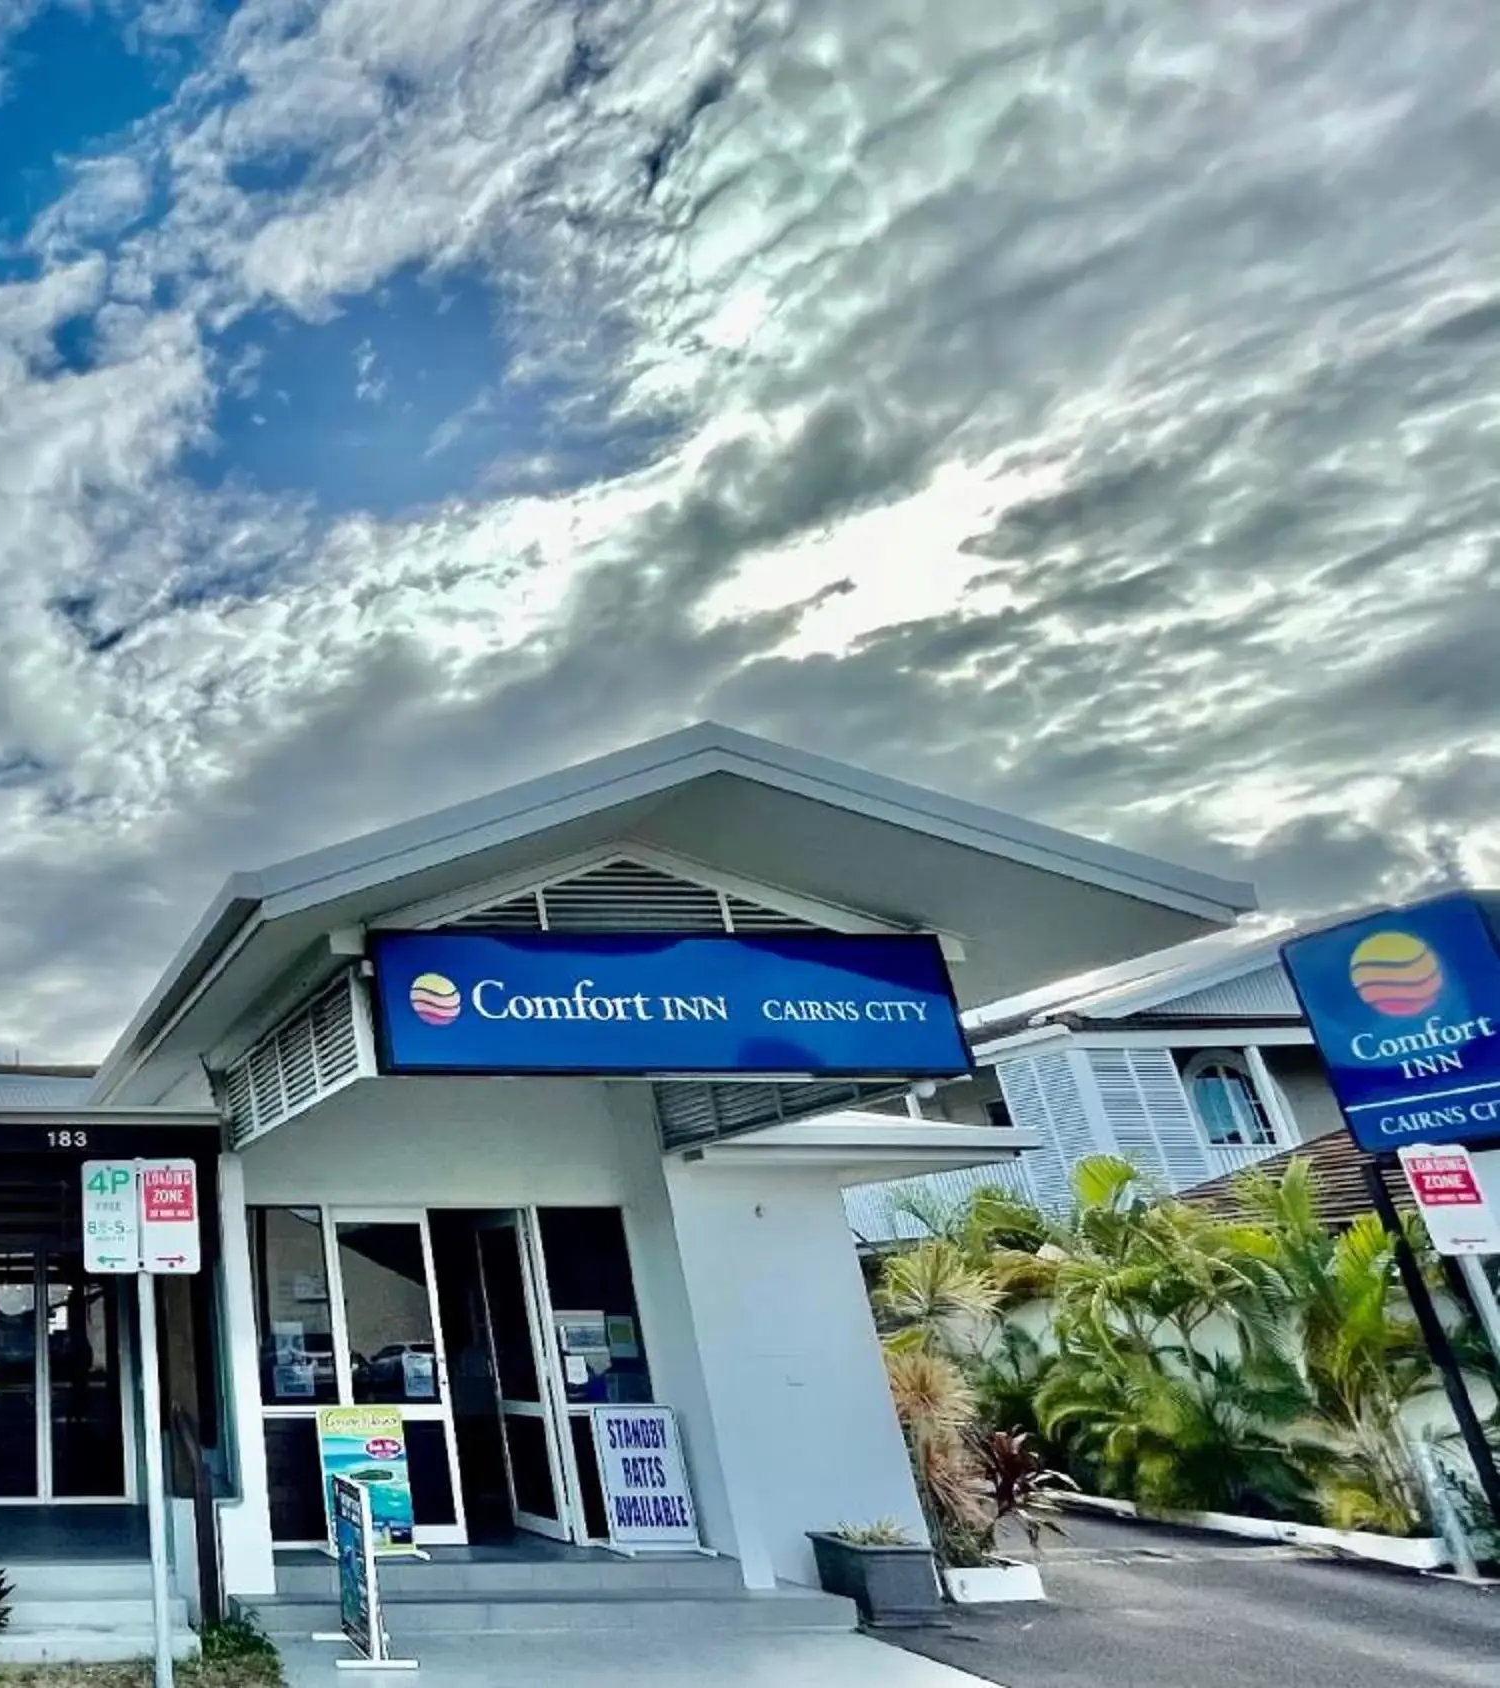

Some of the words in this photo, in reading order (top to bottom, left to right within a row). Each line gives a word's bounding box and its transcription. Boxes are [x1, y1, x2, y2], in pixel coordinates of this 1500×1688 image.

[472, 979, 653, 1022] Comfort
[663, 995, 728, 1021] INN
[762, 999, 859, 1022] CAIRNS
[866, 1000, 928, 1022] CITY
[1350, 1015, 1497, 1061] Comfort
[1399, 1049, 1464, 1079] INN
[1380, 1105, 1467, 1135] CAIRNS
[1469, 1099, 1500, 1121] CI
[47, 1131, 88, 1147] 183
[86, 1169, 130, 1195] 4P
[144, 1170, 192, 1186] LOADING
[1422, 1173, 1468, 1190] ZONE
[151, 1188, 186, 1204] ZONE
[606, 1417, 667, 1449] STANDBY
[621, 1456, 667, 1489] RATES
[614, 1495, 689, 1527] AVAILABLE
